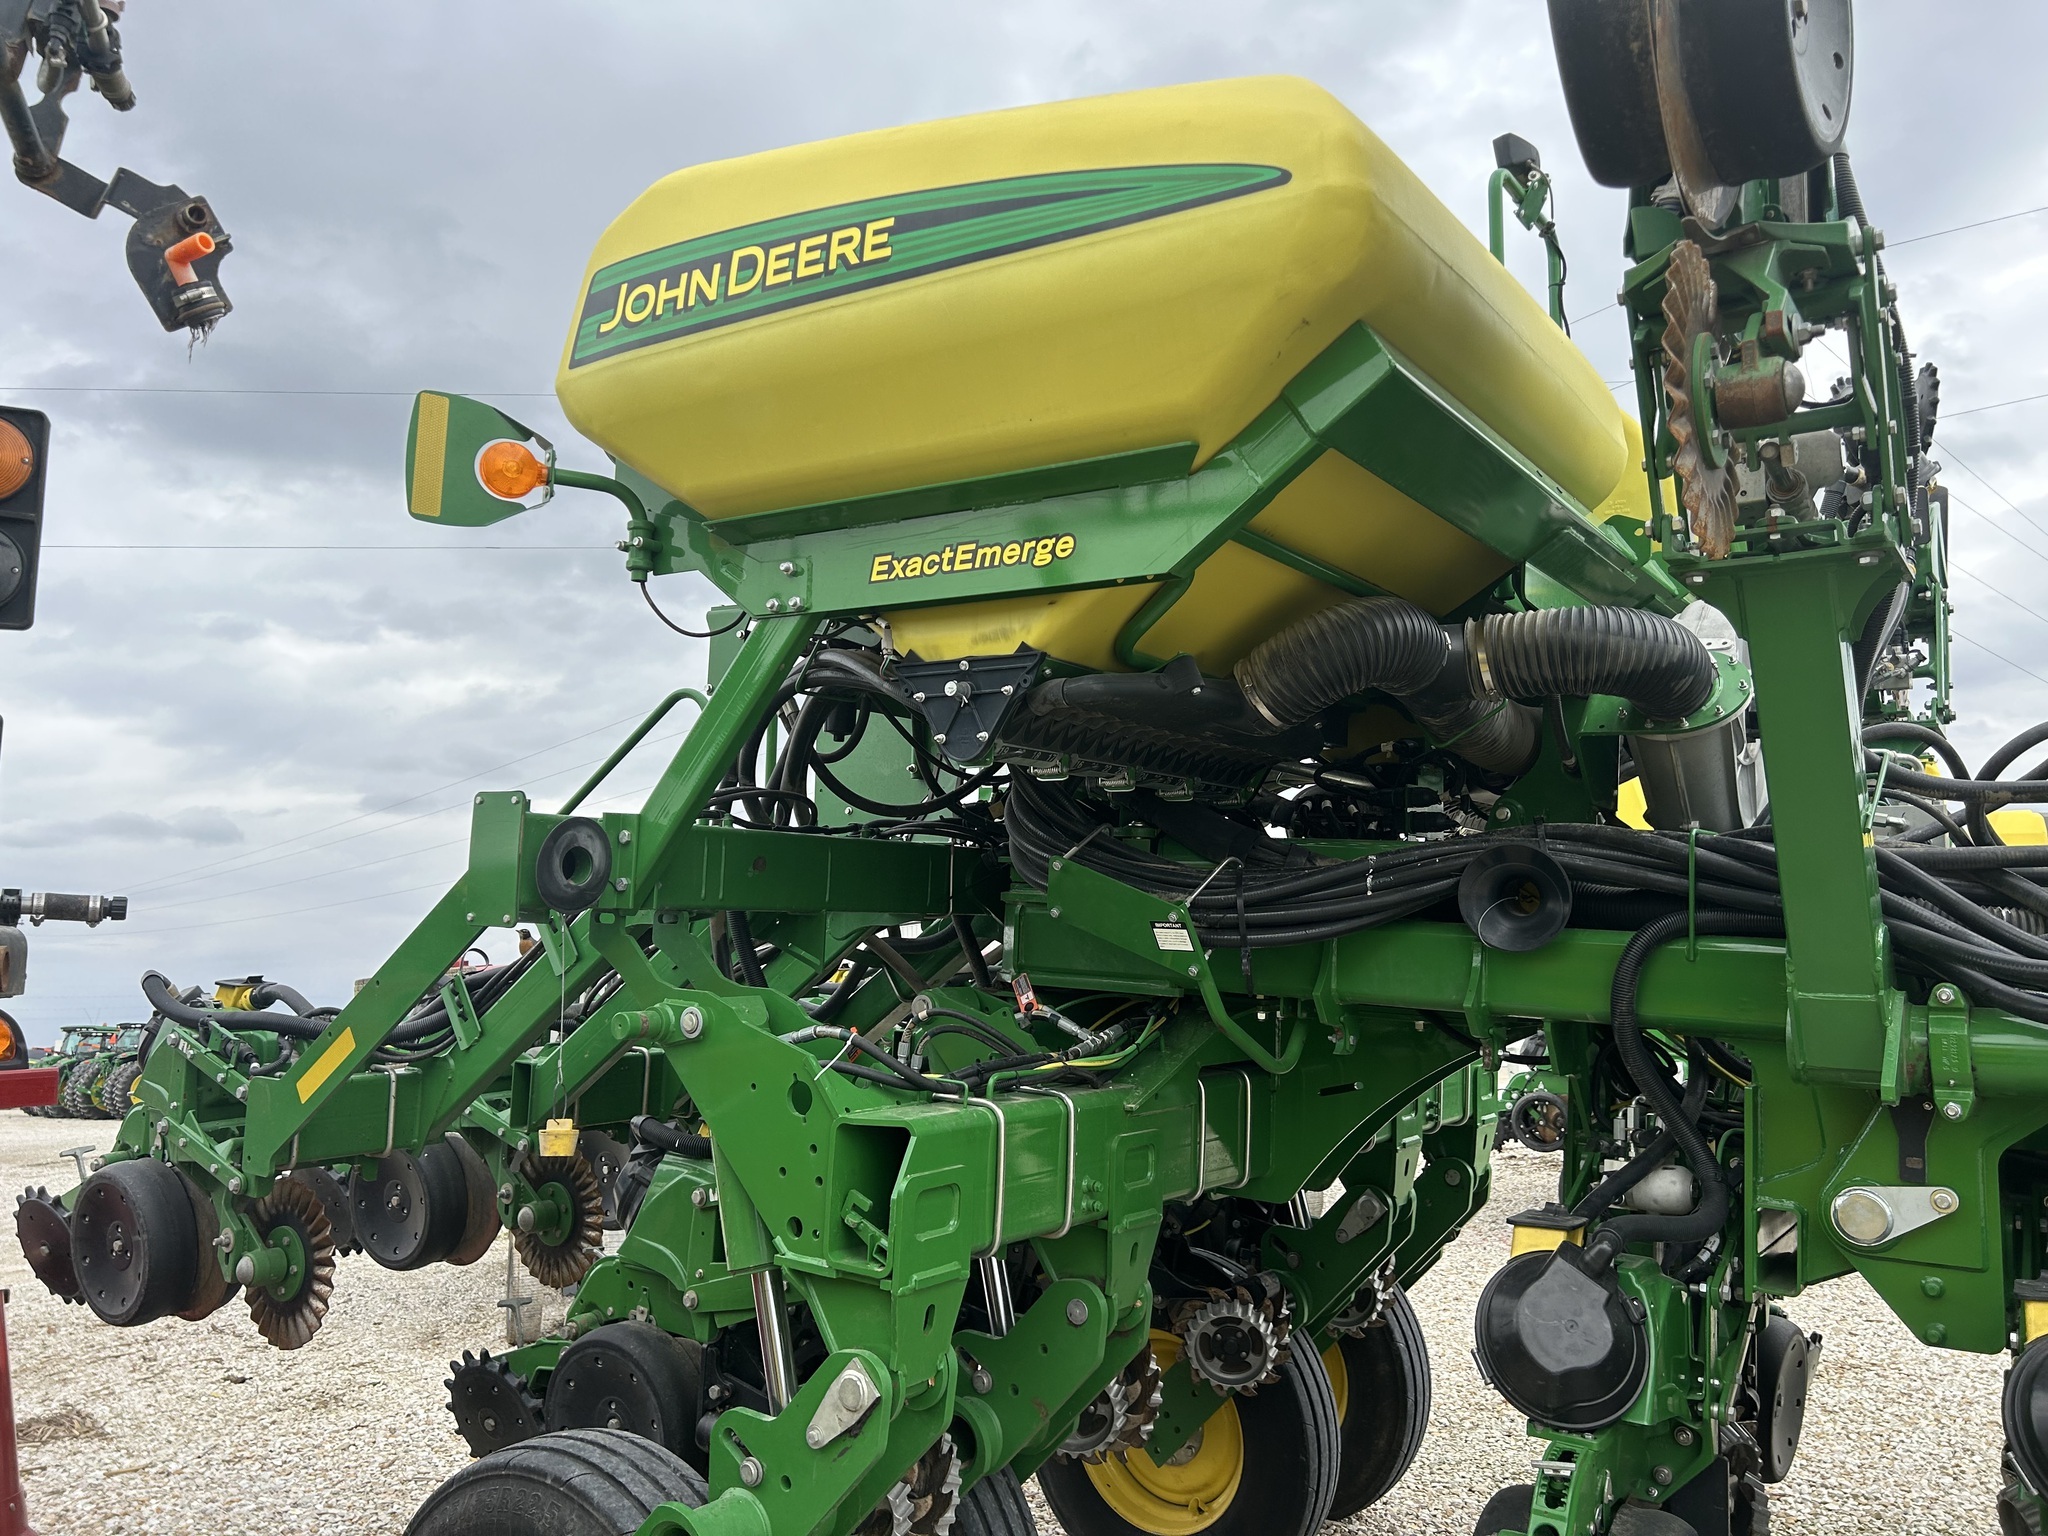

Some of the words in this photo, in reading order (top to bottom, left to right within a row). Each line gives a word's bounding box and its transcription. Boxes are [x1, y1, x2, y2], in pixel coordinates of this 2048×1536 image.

[599, 262, 722, 333] JOHN
[727, 217, 895, 297] DEERE
[870, 534, 1075, 583] ExactEmerge
